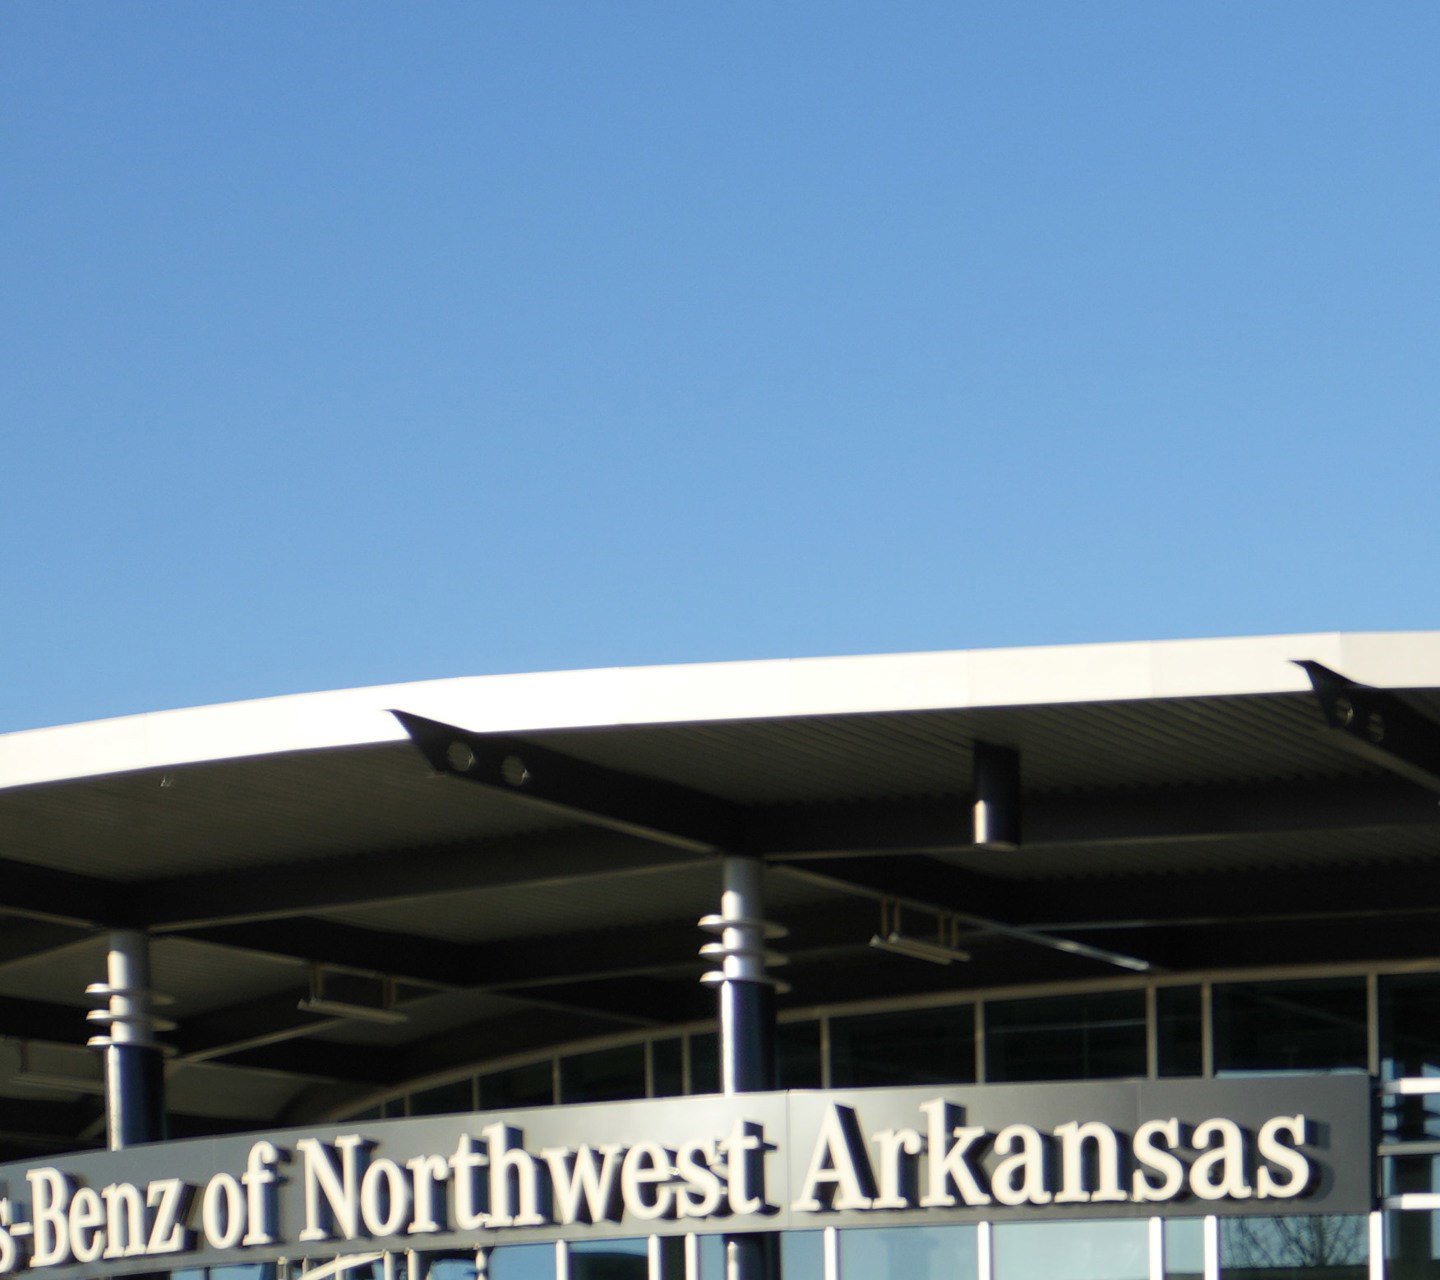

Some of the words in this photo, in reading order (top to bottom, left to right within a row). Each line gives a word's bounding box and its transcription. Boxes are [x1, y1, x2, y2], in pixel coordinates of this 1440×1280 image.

[202, 1140, 278, 1250] of
[297, 1120, 766, 1242] Northwest
[790, 1098, 1311, 1212] Arkansas
